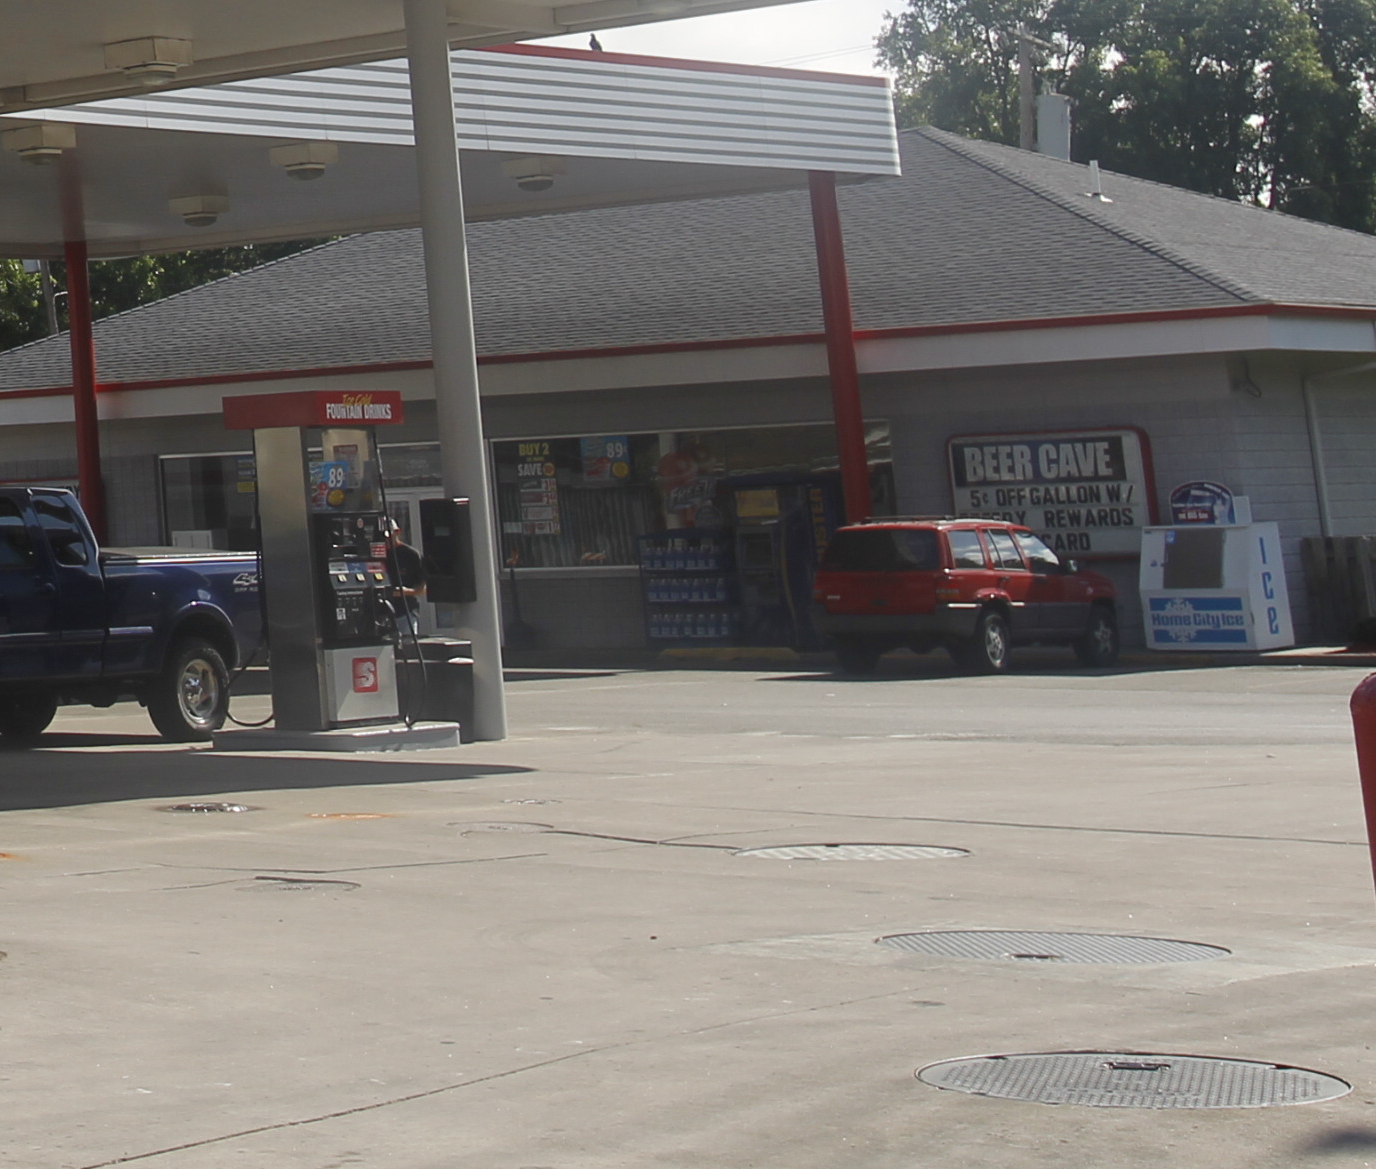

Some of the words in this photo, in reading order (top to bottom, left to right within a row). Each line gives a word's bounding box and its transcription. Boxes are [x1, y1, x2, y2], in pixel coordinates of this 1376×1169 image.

[326, 403, 363, 420] FOUNTAIN
[363, 403, 392, 420] DRINKS
[519, 443, 540, 456] BUY
[542, 442, 550, 455] 2
[517, 463, 542, 477] SAVE
[964, 444, 1034, 482] BEER
[1038, 441, 1113, 480] CAVE
[997, 488, 1026, 506] OFF
[1029, 485, 1102, 505] GALLON
[1043, 507, 1134, 529] REWARDS
[1151, 612, 1191, 627] Home
[1192, 612, 1222, 629] City
[1222, 613, 1244, 627] Ice
